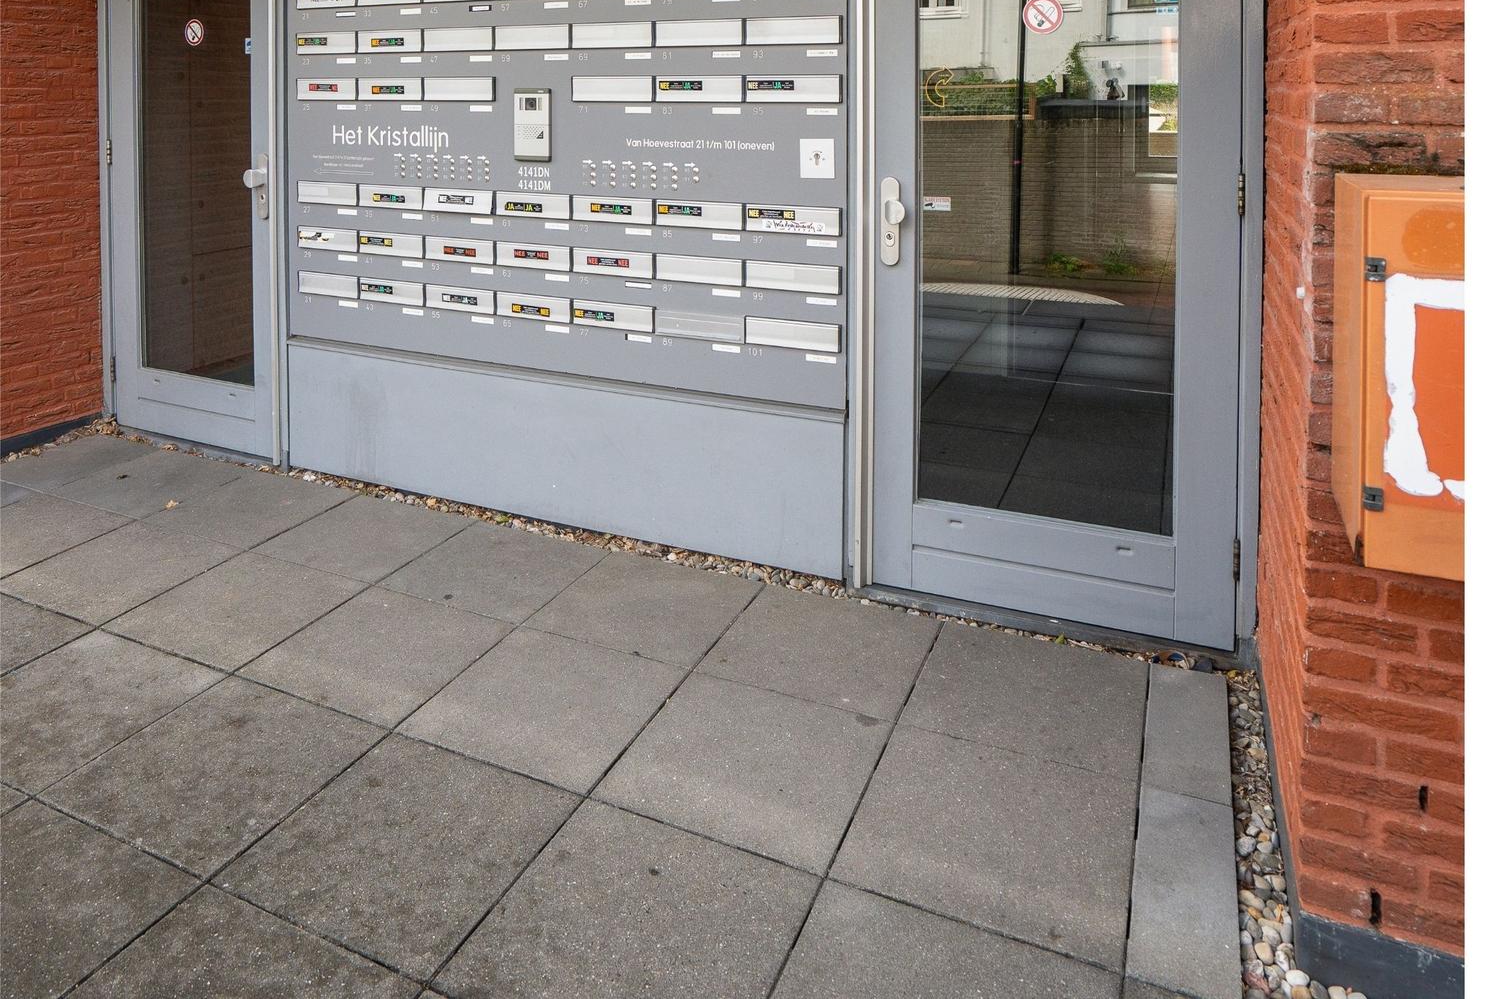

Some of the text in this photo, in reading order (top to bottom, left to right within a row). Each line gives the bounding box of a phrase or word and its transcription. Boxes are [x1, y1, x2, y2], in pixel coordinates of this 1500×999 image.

[578, 53, 588, 61] 69
[752, 51, 764, 59] 93
[748, 81, 758, 90] NEE
[753, 107, 764, 115] 95
[332, 125, 449, 153] Het Kristallijn
[626, 138, 775, 151] Van Hoevestraat 21 t/m 101 (oneven)
[518, 167, 550, 178] 4141DN
[518, 180, 551, 191] 4141DM
[749, 209, 759, 218] NEE
[783, 210, 795, 219] NEE
[662, 230, 672, 238] 85
[752, 236, 763, 244] 97
[752, 292, 763, 300] 99
[662, 338, 672, 346] 89
[748, 348, 763, 356] 101
